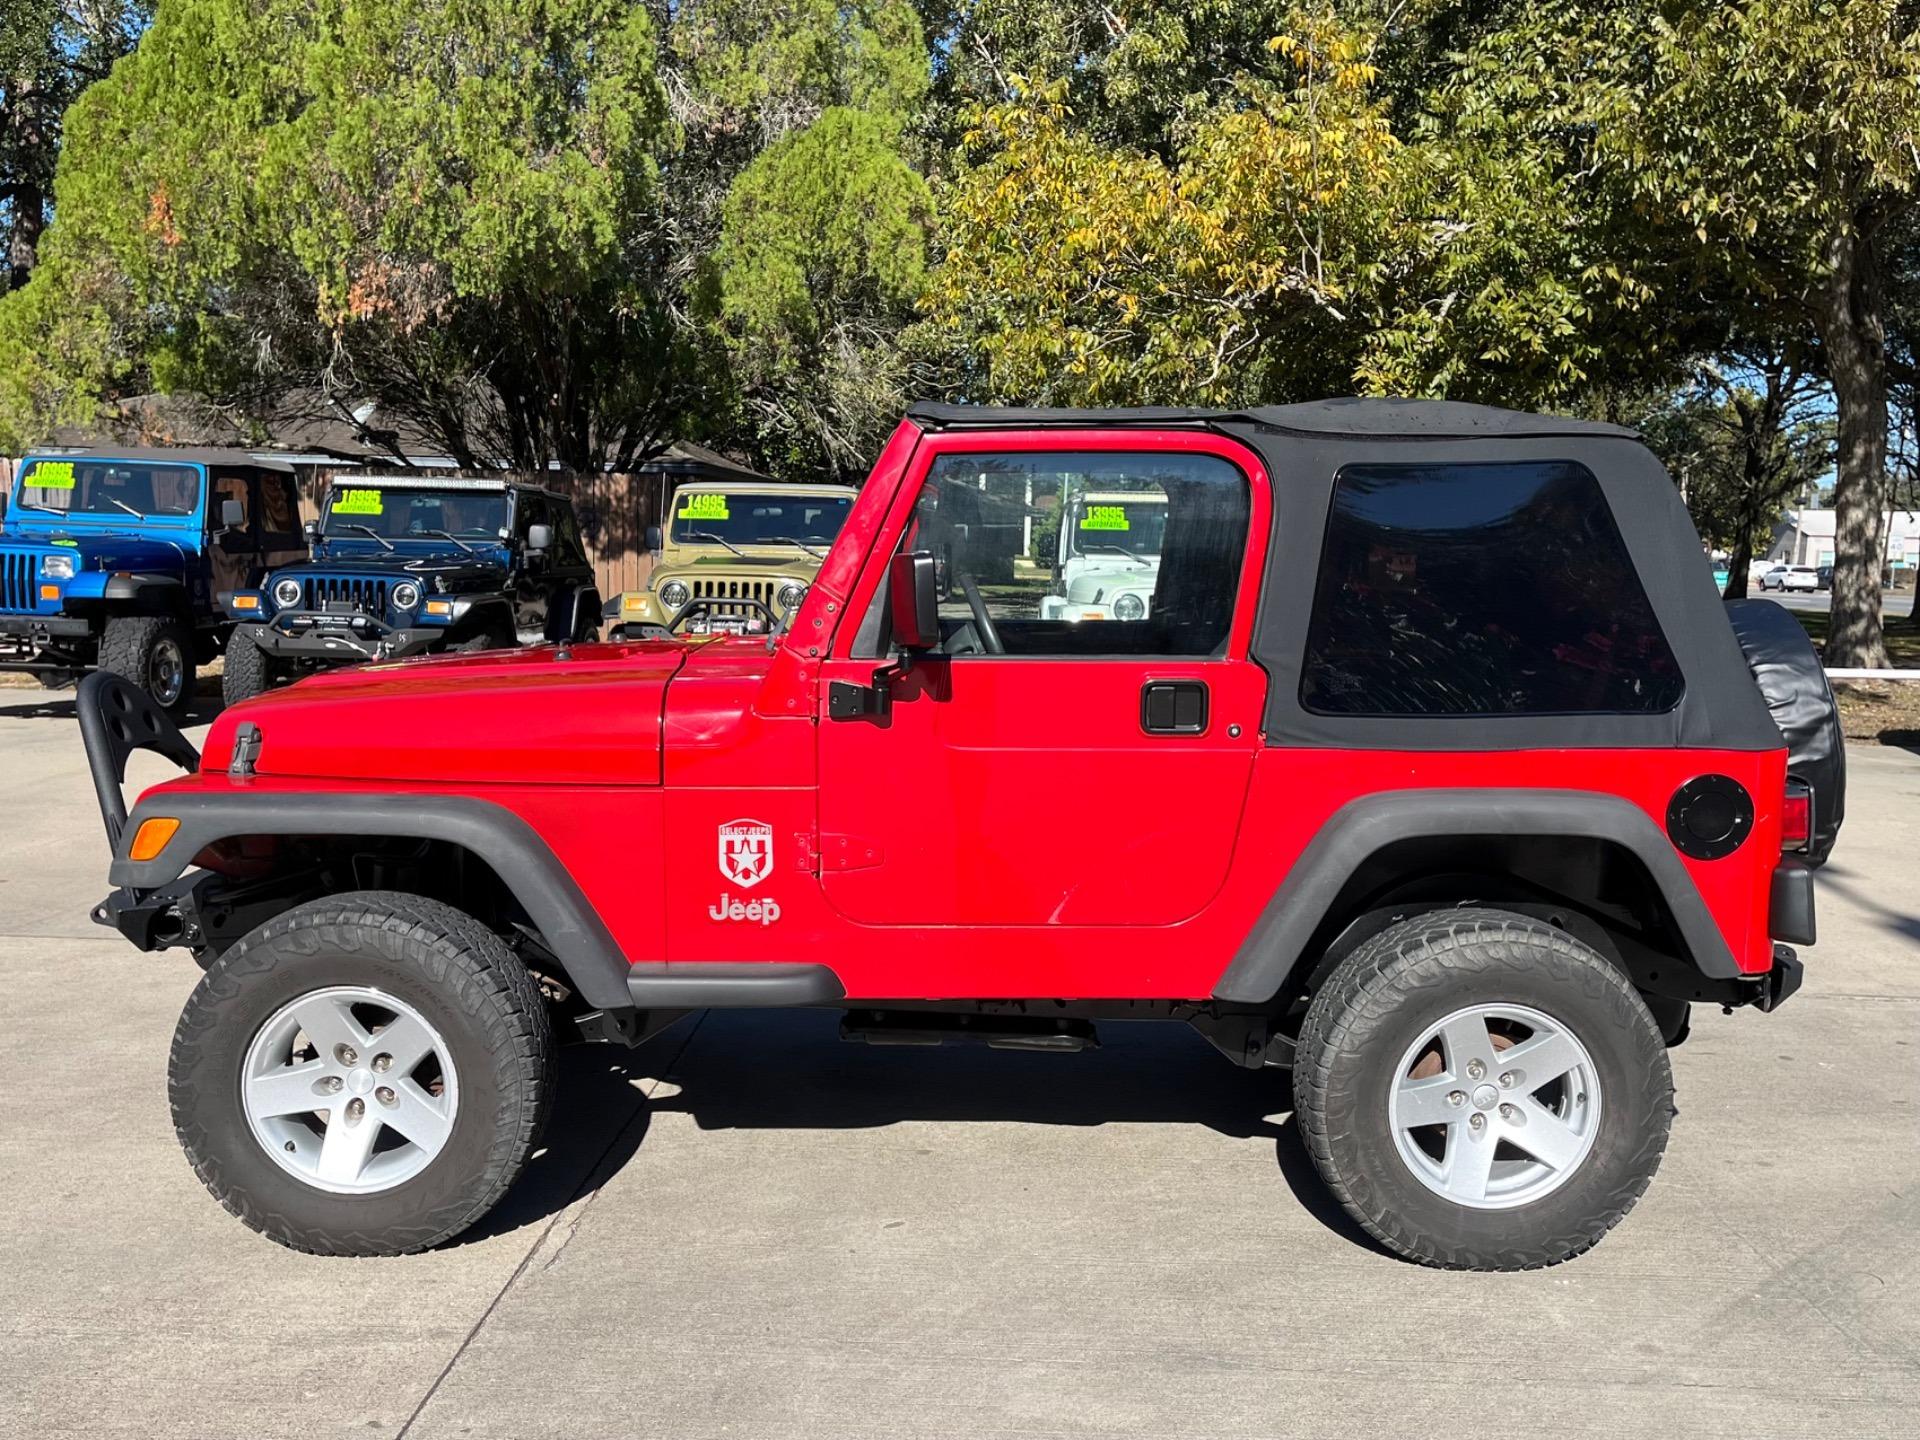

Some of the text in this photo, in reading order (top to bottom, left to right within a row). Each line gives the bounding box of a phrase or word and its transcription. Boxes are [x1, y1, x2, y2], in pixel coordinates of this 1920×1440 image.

[342, 489, 381, 504] 16995
[688, 494, 726, 510] 14995
[340, 504, 376, 512] AUTOMATIC
[1087, 506, 1124, 521] 13995
[1087, 520, 1122, 528] AUTOMATIC
[708, 892, 781, 926] Jeep
